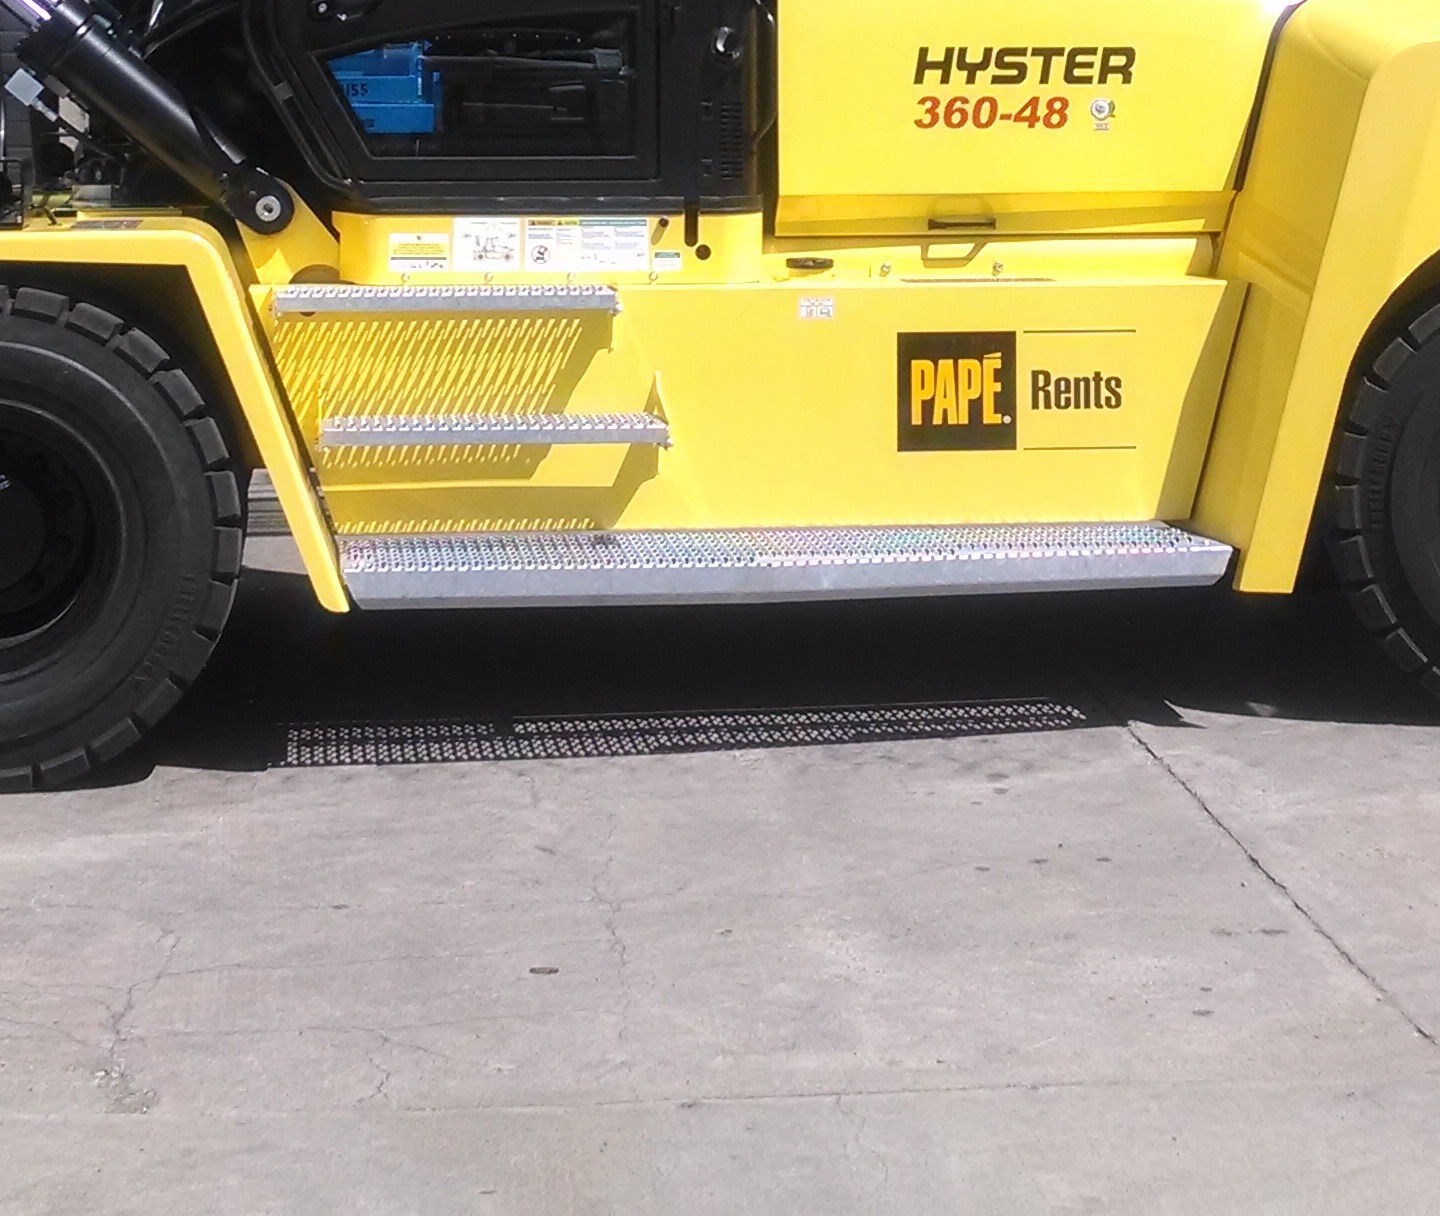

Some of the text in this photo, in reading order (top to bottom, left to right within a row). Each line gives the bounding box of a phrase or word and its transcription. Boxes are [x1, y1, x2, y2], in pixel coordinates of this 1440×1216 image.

[913, 46, 1137, 85] HYSTER
[913, 96, 1070, 129] 360-48
[911, 351, 1122, 425] PAPÉ Rents
